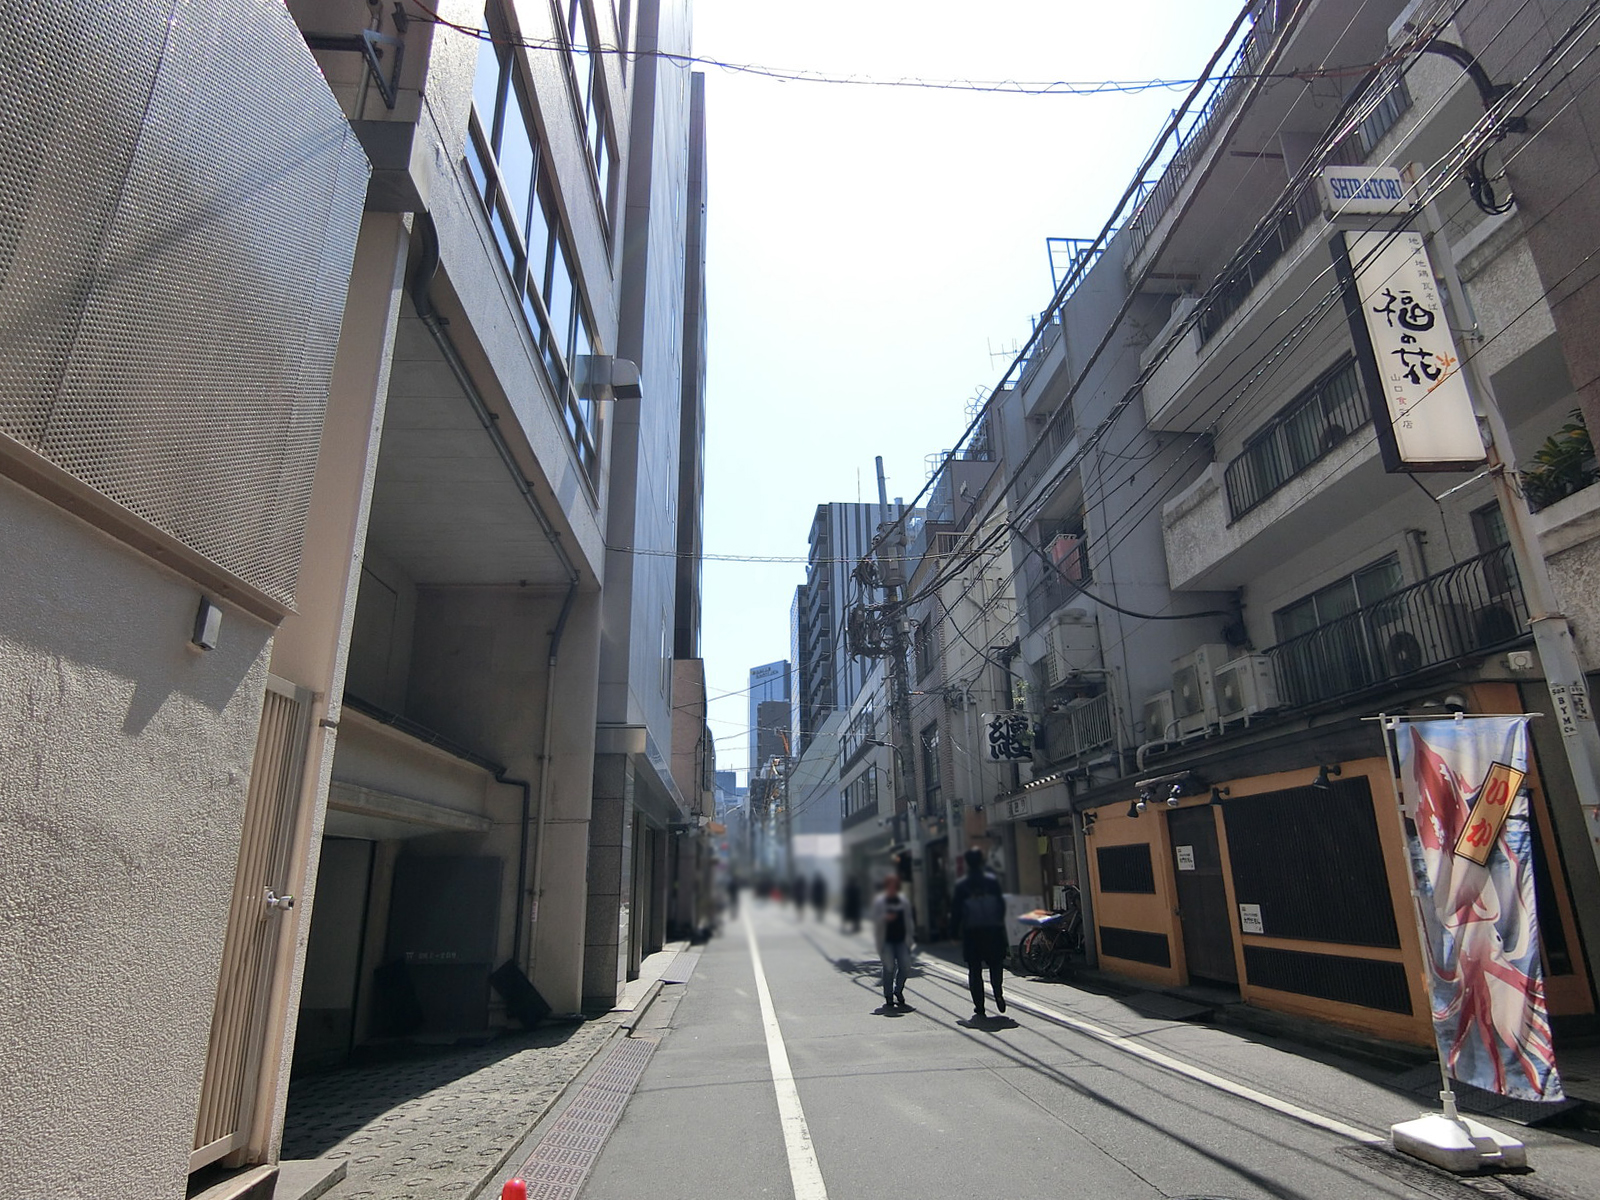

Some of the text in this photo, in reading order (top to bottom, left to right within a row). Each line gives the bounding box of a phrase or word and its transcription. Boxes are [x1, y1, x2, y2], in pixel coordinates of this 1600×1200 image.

[1329, 177, 1406, 200] SHIRATORI
[1372, 287, 1442, 386] 福の花
[1465, 776, 1510, 848] いか
